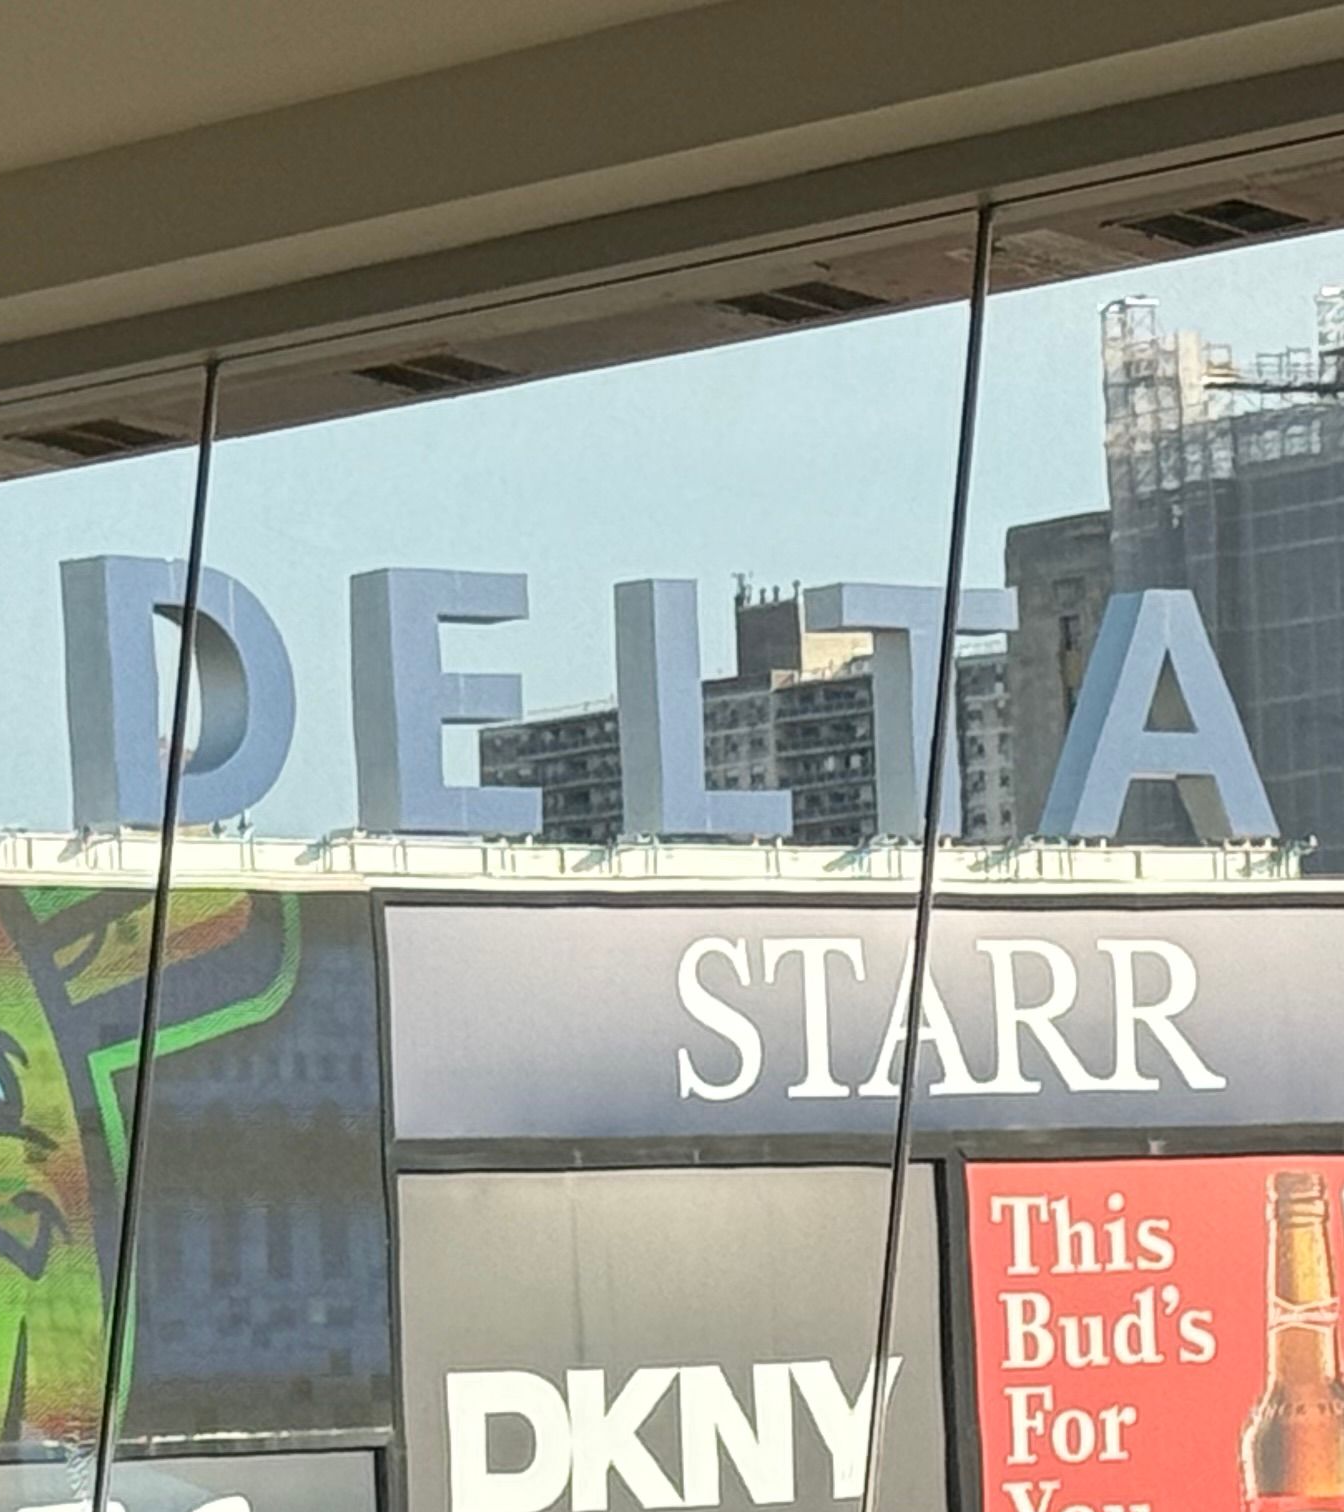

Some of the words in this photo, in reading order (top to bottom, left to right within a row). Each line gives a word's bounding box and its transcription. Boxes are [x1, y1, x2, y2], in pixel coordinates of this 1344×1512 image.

[60, 555, 1278, 838] DELTA
[678, 937, 1226, 1100] STARR
[991, 1193, 1175, 1276] This
[998, 1285, 1217, 1370] Bud's
[1004, 1384, 1137, 1466] For
